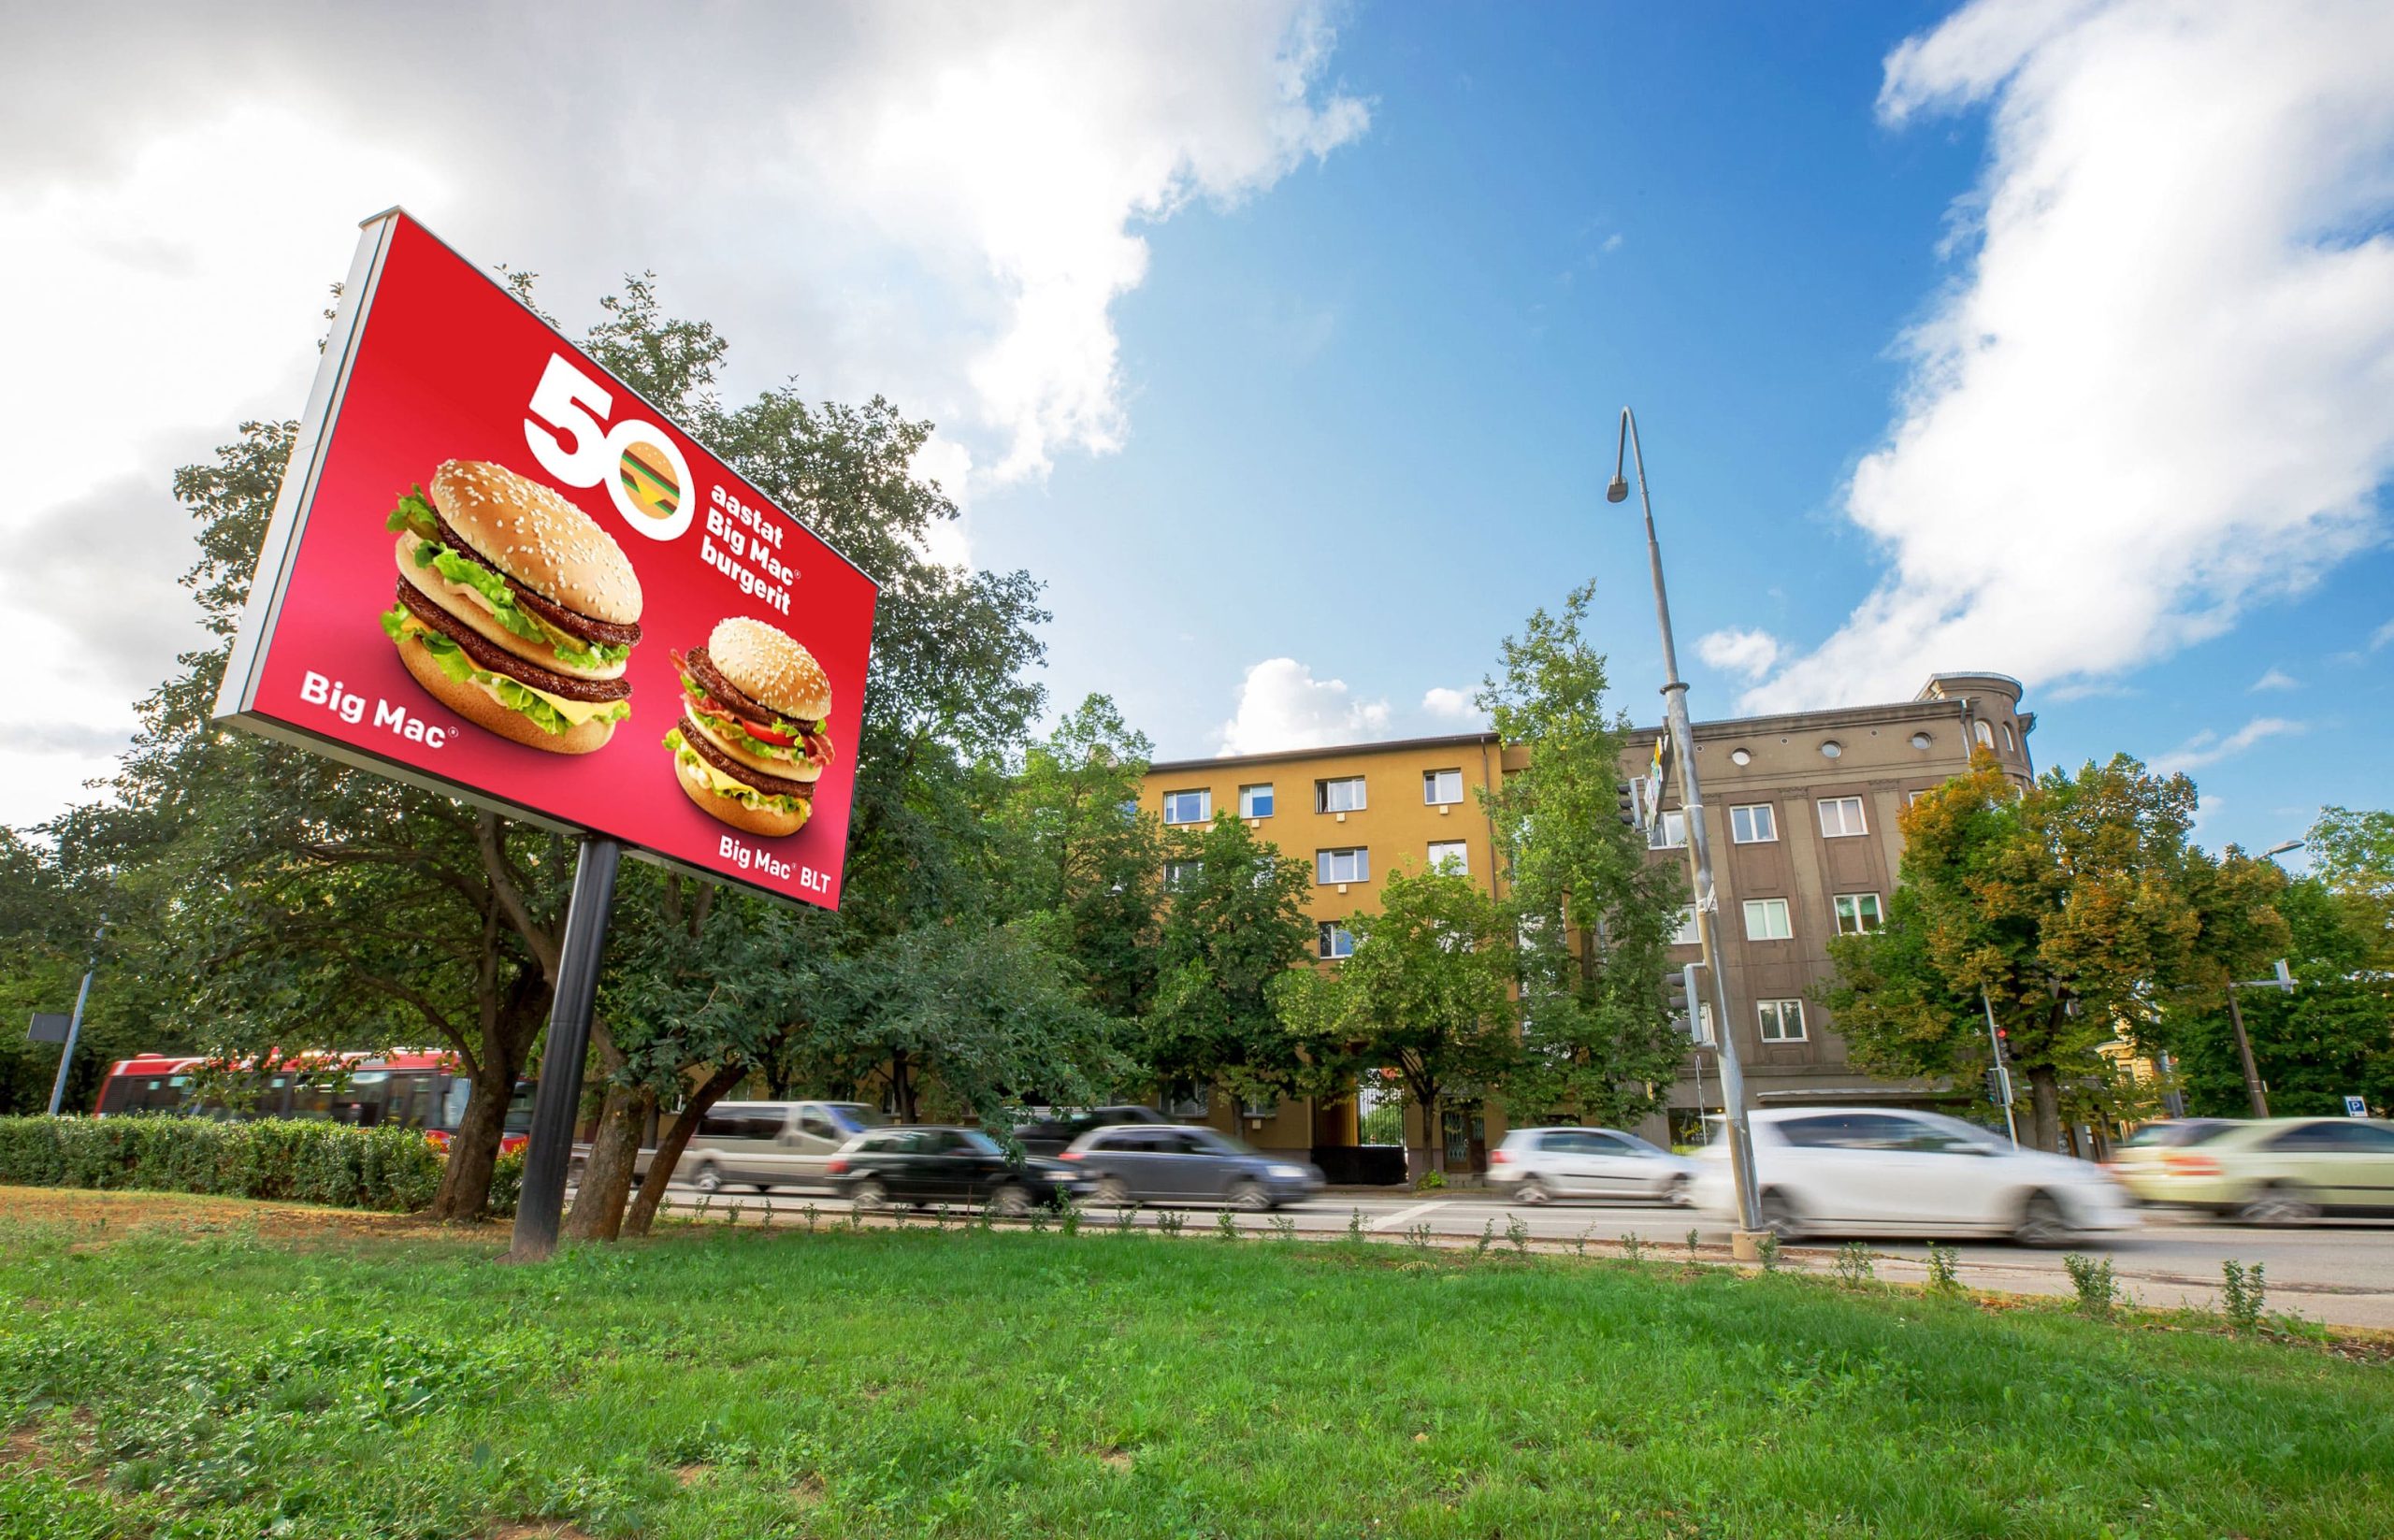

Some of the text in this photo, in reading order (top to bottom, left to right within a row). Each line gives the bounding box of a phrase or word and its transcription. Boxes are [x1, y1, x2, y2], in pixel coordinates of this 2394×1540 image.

[523, 351, 697, 541] 50
[706, 506, 746, 556] Big
[711, 483, 784, 551] aastat
[700, 534, 791, 617] burgerit
[299, 669, 368, 725] Big
[718, 834, 751, 870] Big
[800, 866, 831, 894] BLT
